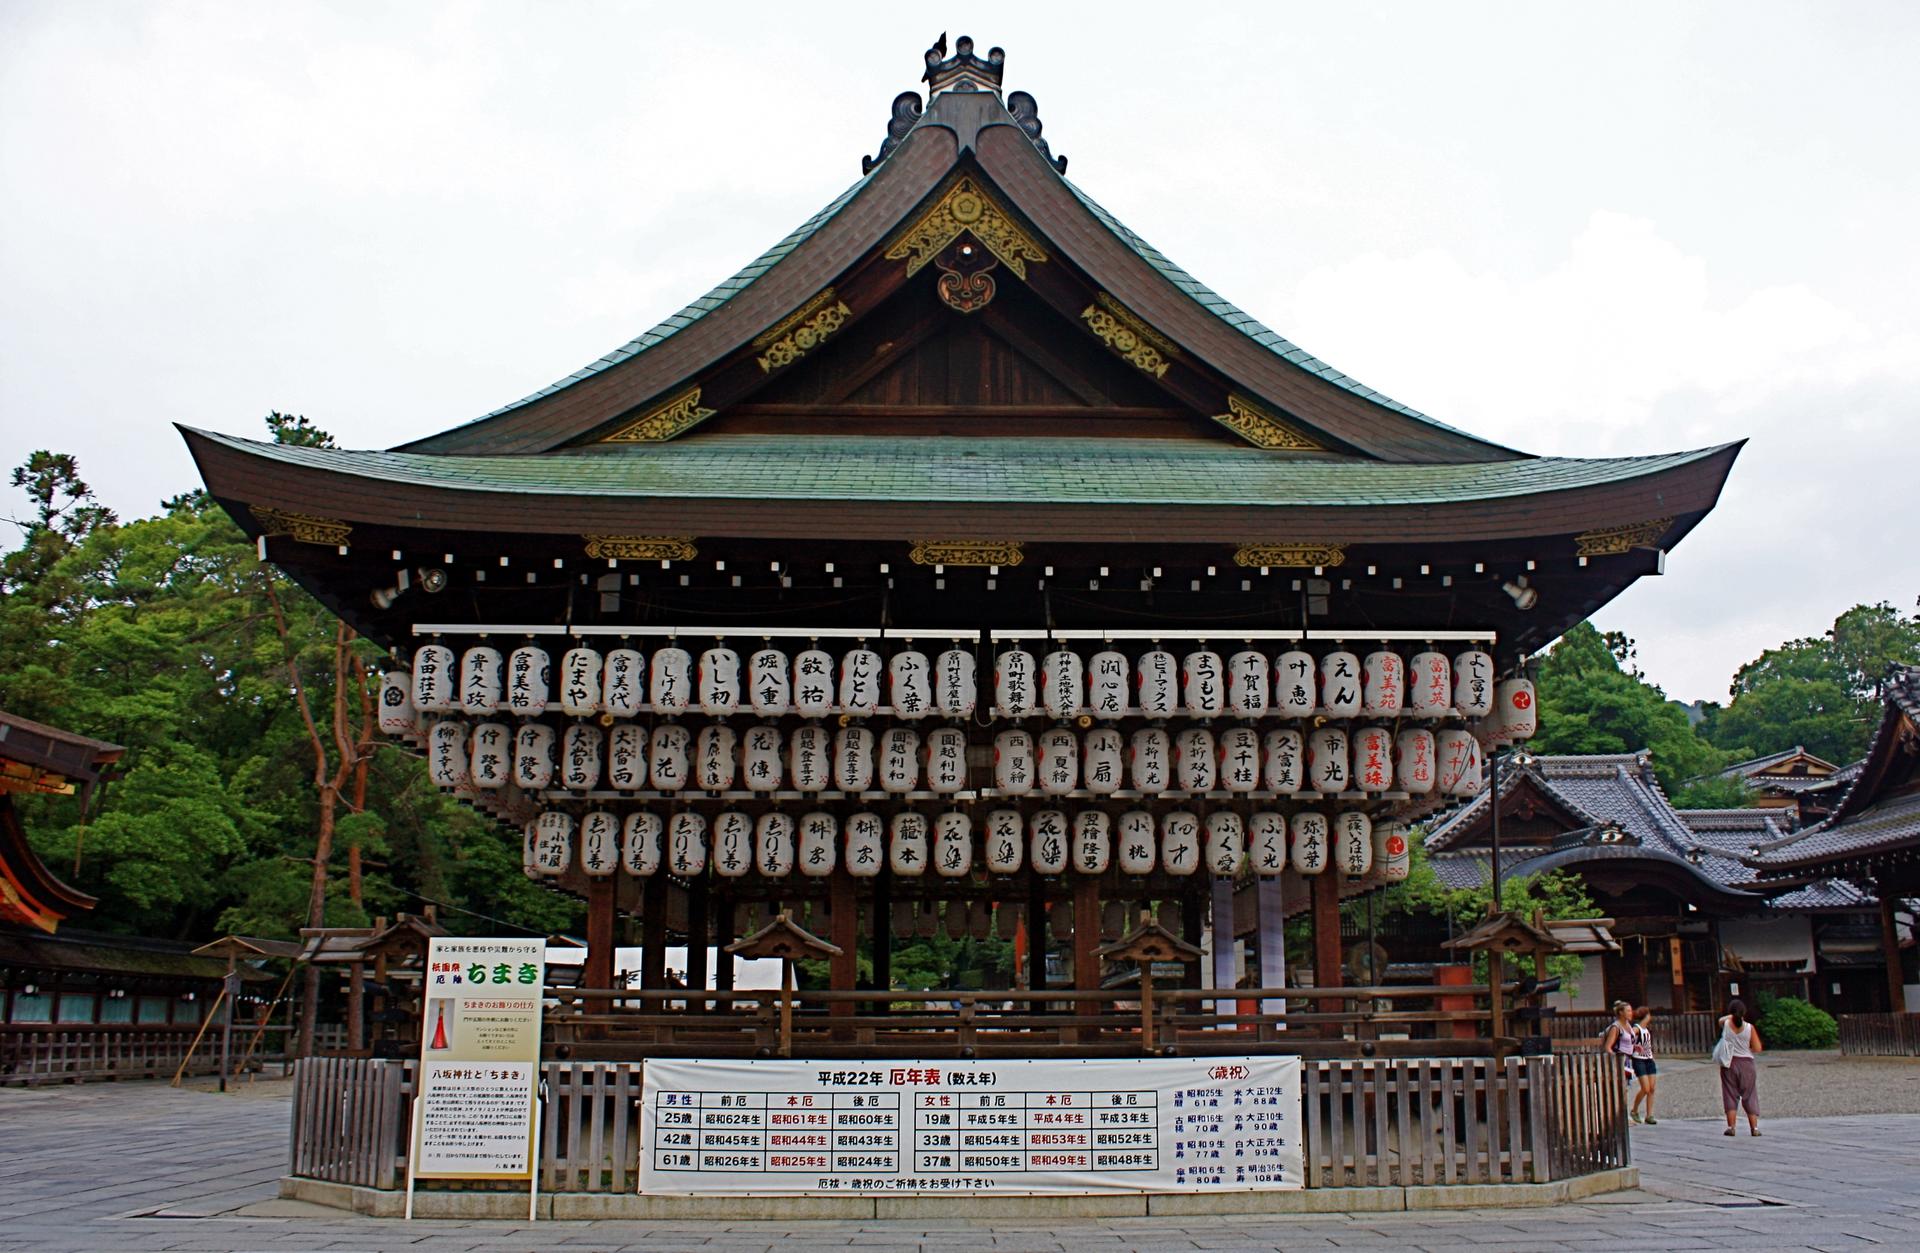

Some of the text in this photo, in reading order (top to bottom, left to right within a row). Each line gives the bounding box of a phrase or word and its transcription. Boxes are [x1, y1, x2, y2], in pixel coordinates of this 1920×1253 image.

[418, 648, 440, 705] 家田荘子
[466, 652, 489, 708] 貴久政
[568, 652, 588, 707] たまや
[610, 654, 632, 710] 富美代
[710, 654, 731, 706] いし初
[758, 654, 782, 706] 堀八重
[800, 656, 826, 704] 敏祐
[900, 656, 922, 714] ふく葉
[946, 651, 962, 714] 宮川町お茶屋組合
[1007, 652, 1028, 715] 宮川町歌舞会
[1058, 652, 1074, 718] 新神戸土地株式会社
[1196, 654, 1216, 711] まつもと
[1242, 654, 1262, 710] 千賀福
[1288, 659, 1308, 706] 叶恵
[1334, 658, 1356, 705] えん
[1380, 656, 1397, 710] 富美苑
[1428, 657, 1446, 707] 富美英
[1469, 654, 1486, 708] よし富美
[656, 734, 677, 778] 小花
[750, 732, 772, 779] 花傳
[1092, 736, 1115, 782] 小扇
[1233, 732, 1252, 784] 豆千桂
[1276, 735, 1296, 786] 久富美
[1322, 734, 1344, 782] 市光
[1364, 733, 1384, 786] 富美珠
[1128, 818, 1149, 860] 小桃
[1261, 818, 1281, 868] ふく光
[1302, 820, 1321, 868] 弥寿葉
[467, 962, 538, 984] ちまき
[432, 1070, 526, 1080] 八坂神社と「ちまき」
[818, 1071, 884, 1086] 平成22年
[889, 1068, 941, 1086] 厄年表
[1186, 1088, 1224, 1098] 昭和25生
[1245, 1086, 1284, 1096] 大正12生
[664, 1112, 894, 1126] 25歳 昭和62年生 昭和61年生 昭和60年生
[666, 1094, 880, 1108] 男性 前厄 本厄 後厄
[924, 1094, 1138, 1107] 女性 前厄 本厄 後厄
[924, 1112, 1150, 1126] 19歳 平成5年生 平成4年生 平成3年生
[1187, 1114, 1224, 1124] 昭和16生
[1246, 1112, 1284, 1122] 大正10生
[662, 1154, 893, 1168] 61歳 昭和26年生 昭和25年生 昭和24年生
[663, 1133, 894, 1146] 42歳 昭和45年生 昭和44年生 昭和43年生
[922, 1134, 1153, 1147] 33歳 昭和54年生 昭和53年生 昭和52年生
[922, 1154, 1153, 1168] 37歳 昭和50年生 昭和49年生 昭和48年生
[1187, 1140, 1226, 1149] 昭和9生
[1246, 1138, 1286, 1148] 大正元生
